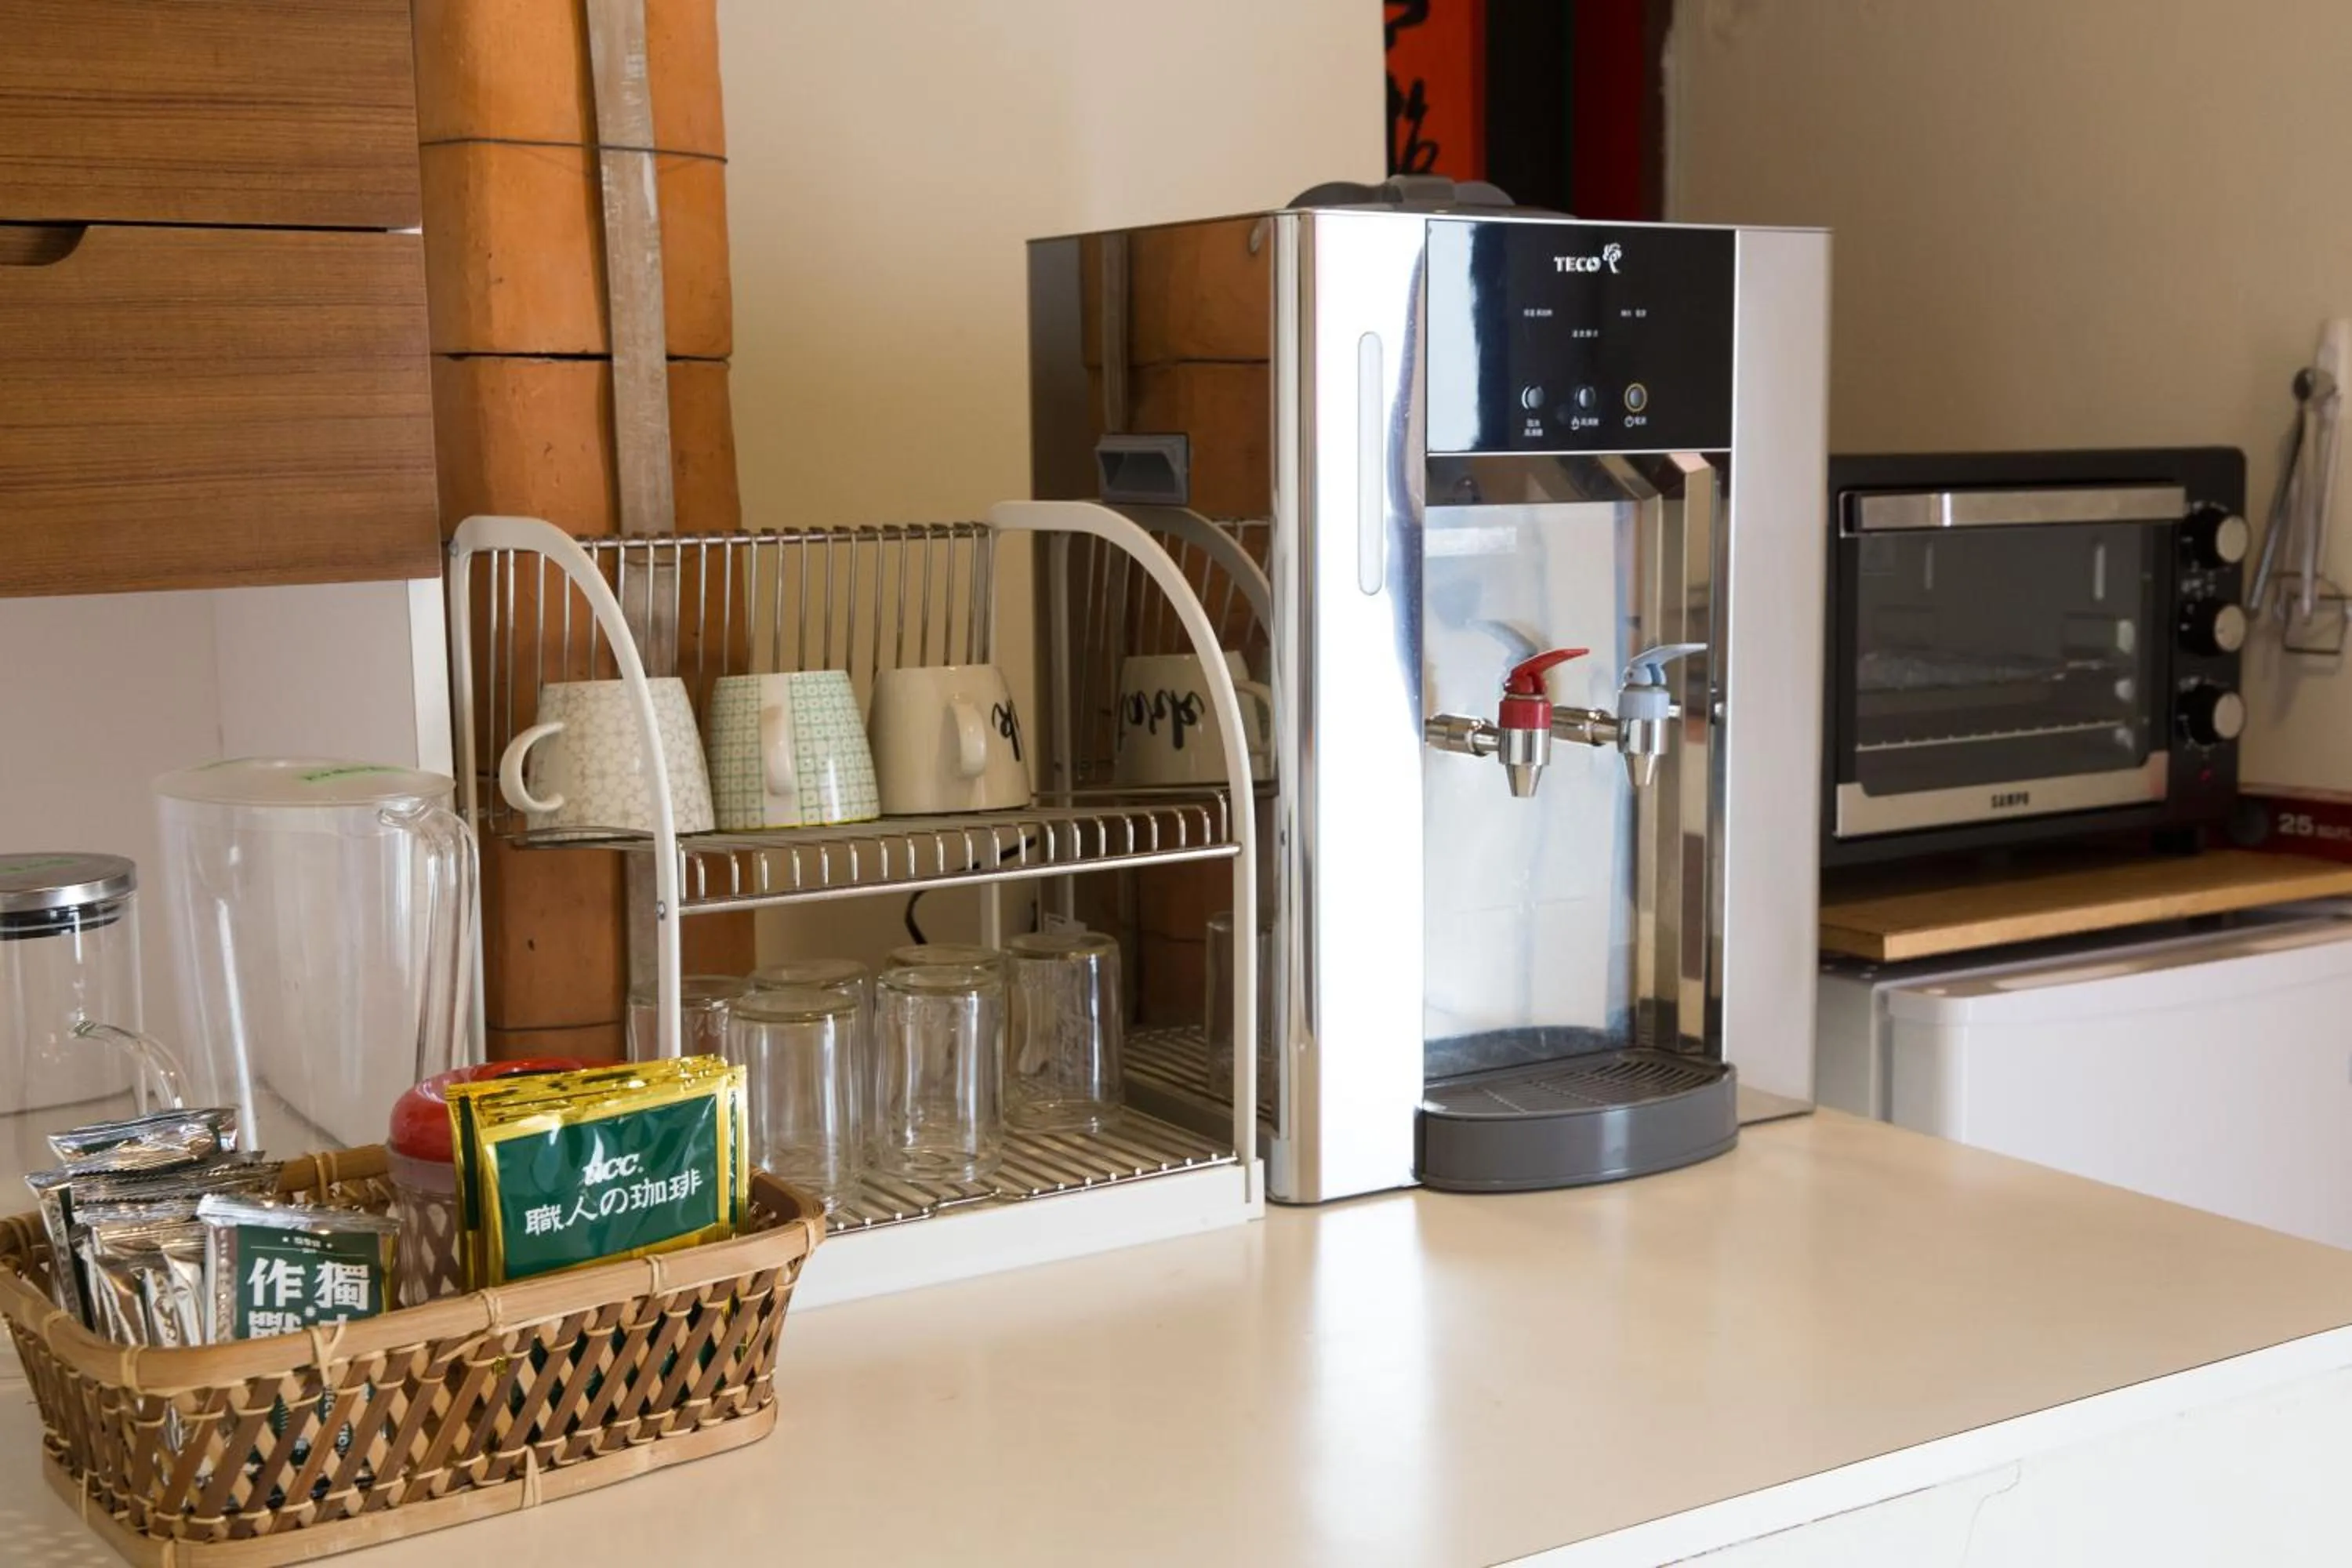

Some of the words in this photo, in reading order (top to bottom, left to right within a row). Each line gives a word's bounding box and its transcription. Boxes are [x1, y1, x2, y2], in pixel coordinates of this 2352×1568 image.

[1553, 256, 1601, 273] TECO
[524, 1167, 703, 1236] 職人の珈琲
